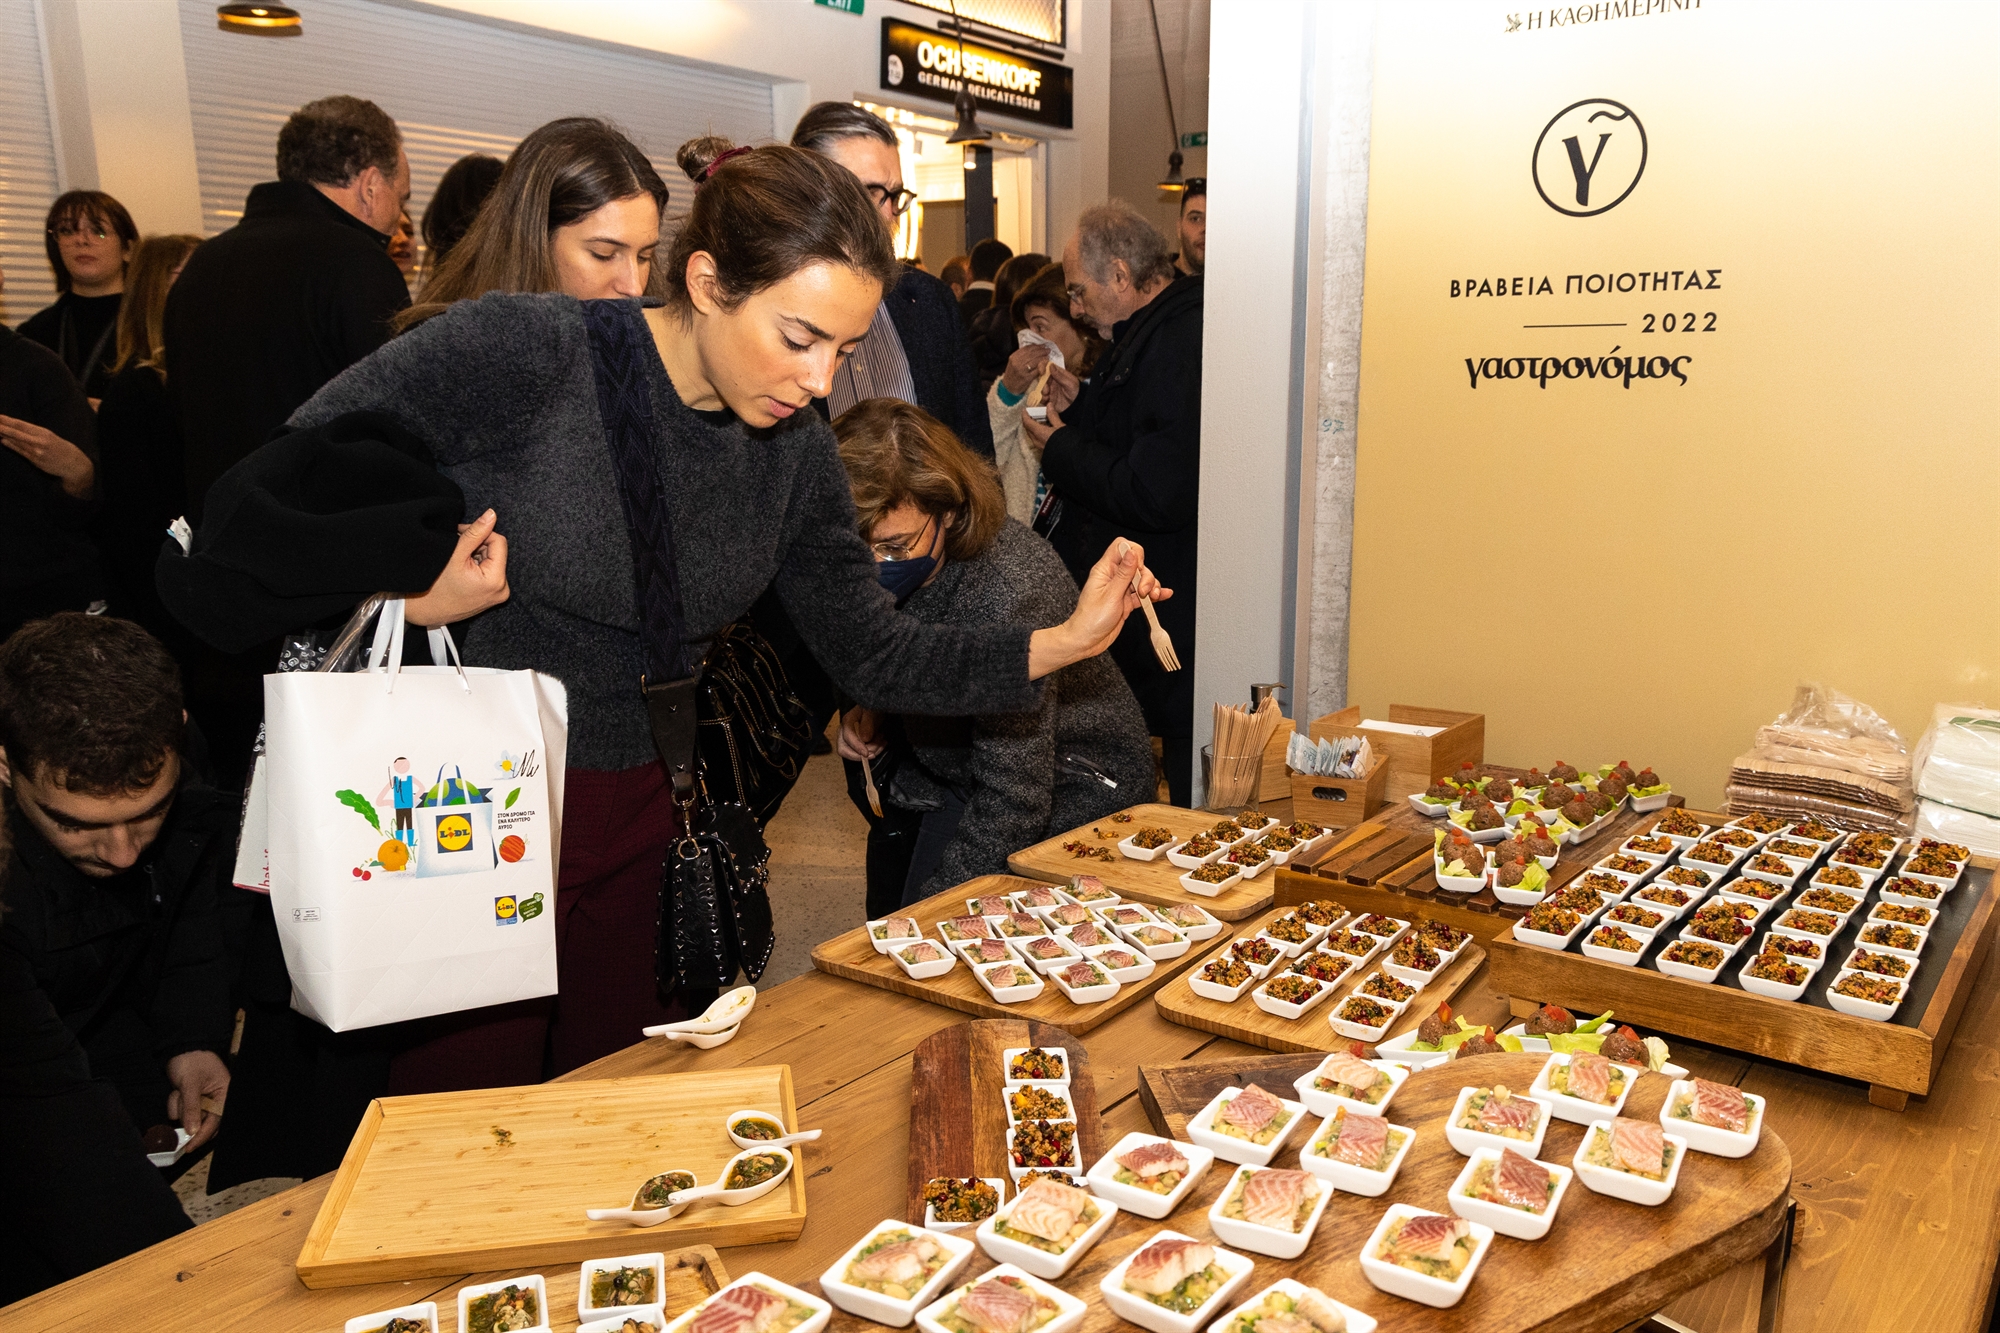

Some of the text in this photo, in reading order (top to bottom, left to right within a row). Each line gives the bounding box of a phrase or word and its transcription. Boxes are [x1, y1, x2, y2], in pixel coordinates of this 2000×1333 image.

[1527, 11, 1543, 30] Η
[917, 40, 1042, 95] OCHSENKOPF
[967, 83, 1041, 112] DELICATESSEN
[1450, 269, 1722, 298] ΒΡΑΒΕΙΑ ΠΟΙΟΤΗΤΑΣ
[1641, 311, 1718, 333] 2022
[1464, 345, 1693, 389] γαστρονόμος
